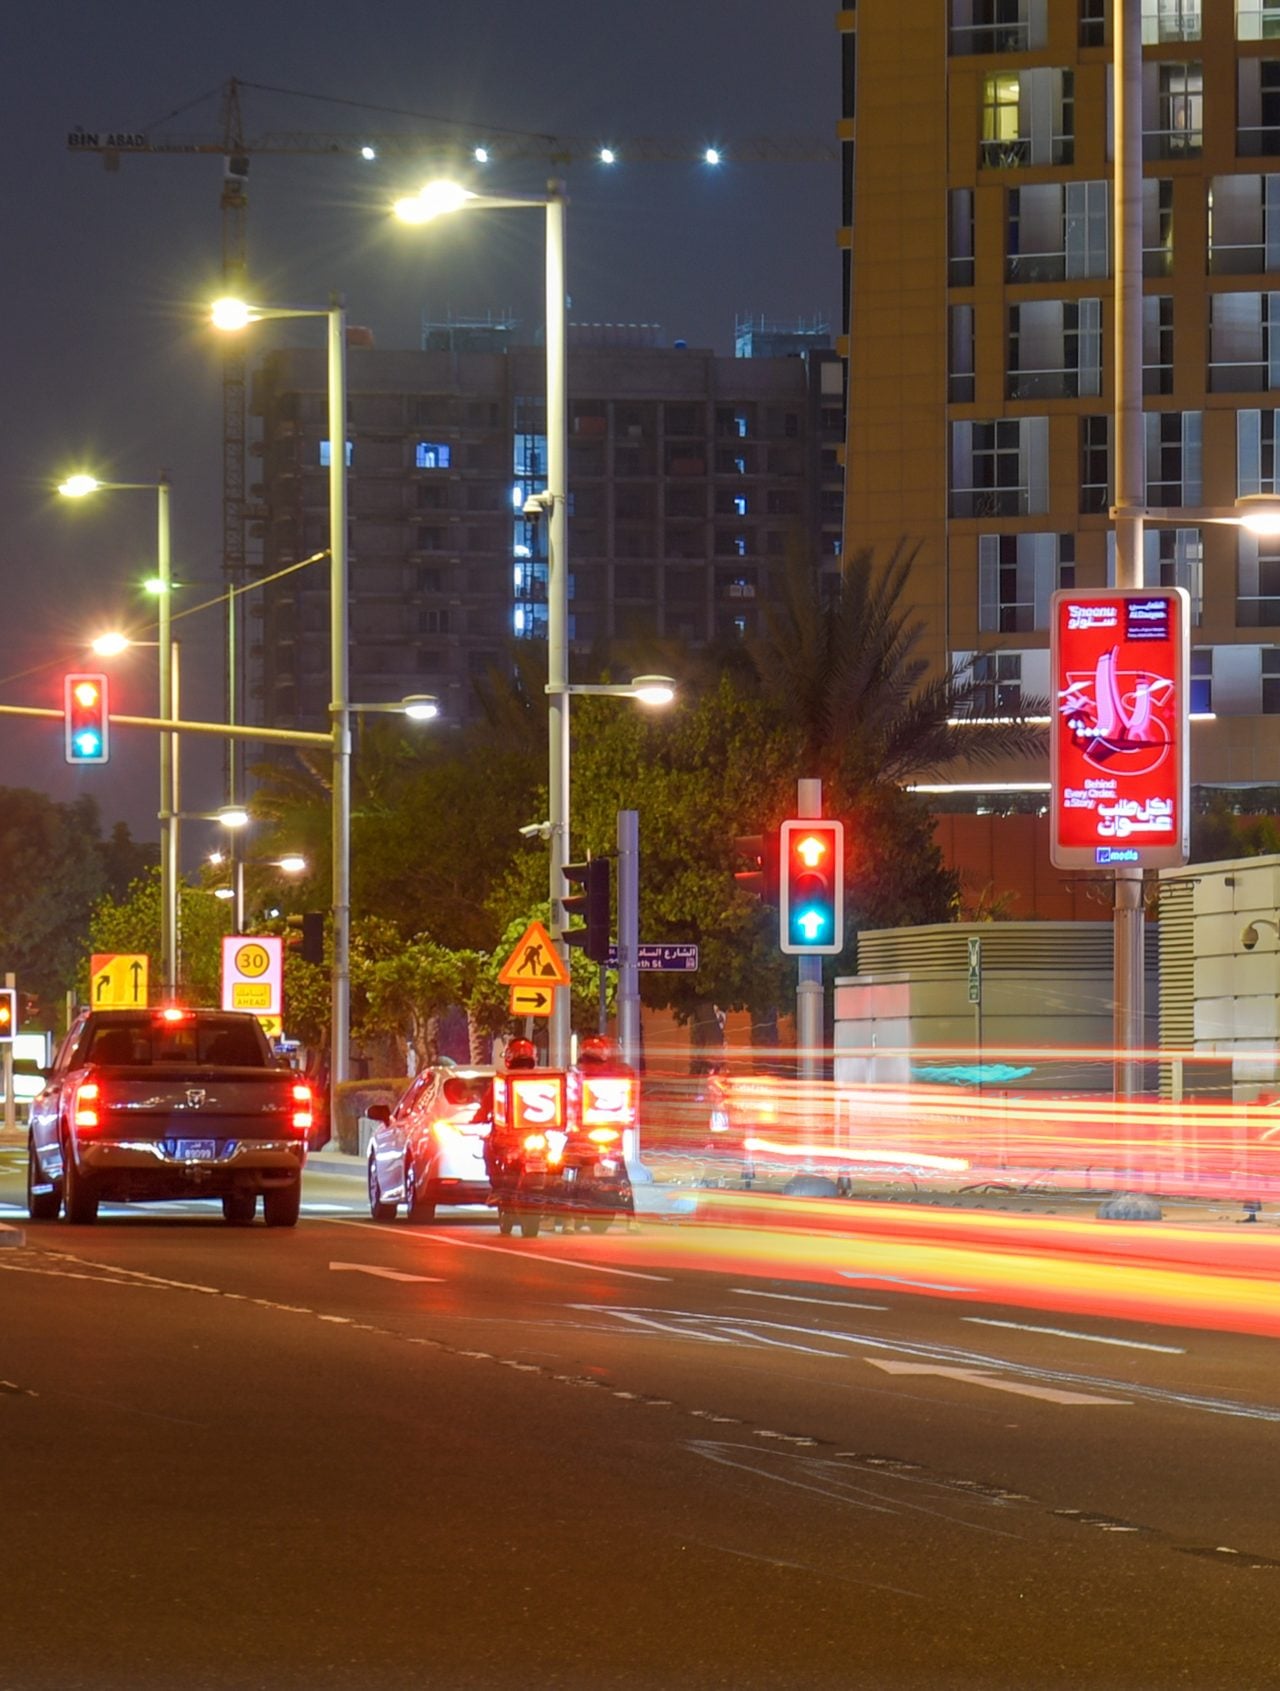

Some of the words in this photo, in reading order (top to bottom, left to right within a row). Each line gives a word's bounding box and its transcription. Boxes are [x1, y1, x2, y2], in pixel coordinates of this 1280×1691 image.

[1067, 605, 1118, 618] Snoonu
[638, 947, 662, 957] الساد
[241, 953, 263, 969] 30
[237, 998, 266, 1006] AHEAD
